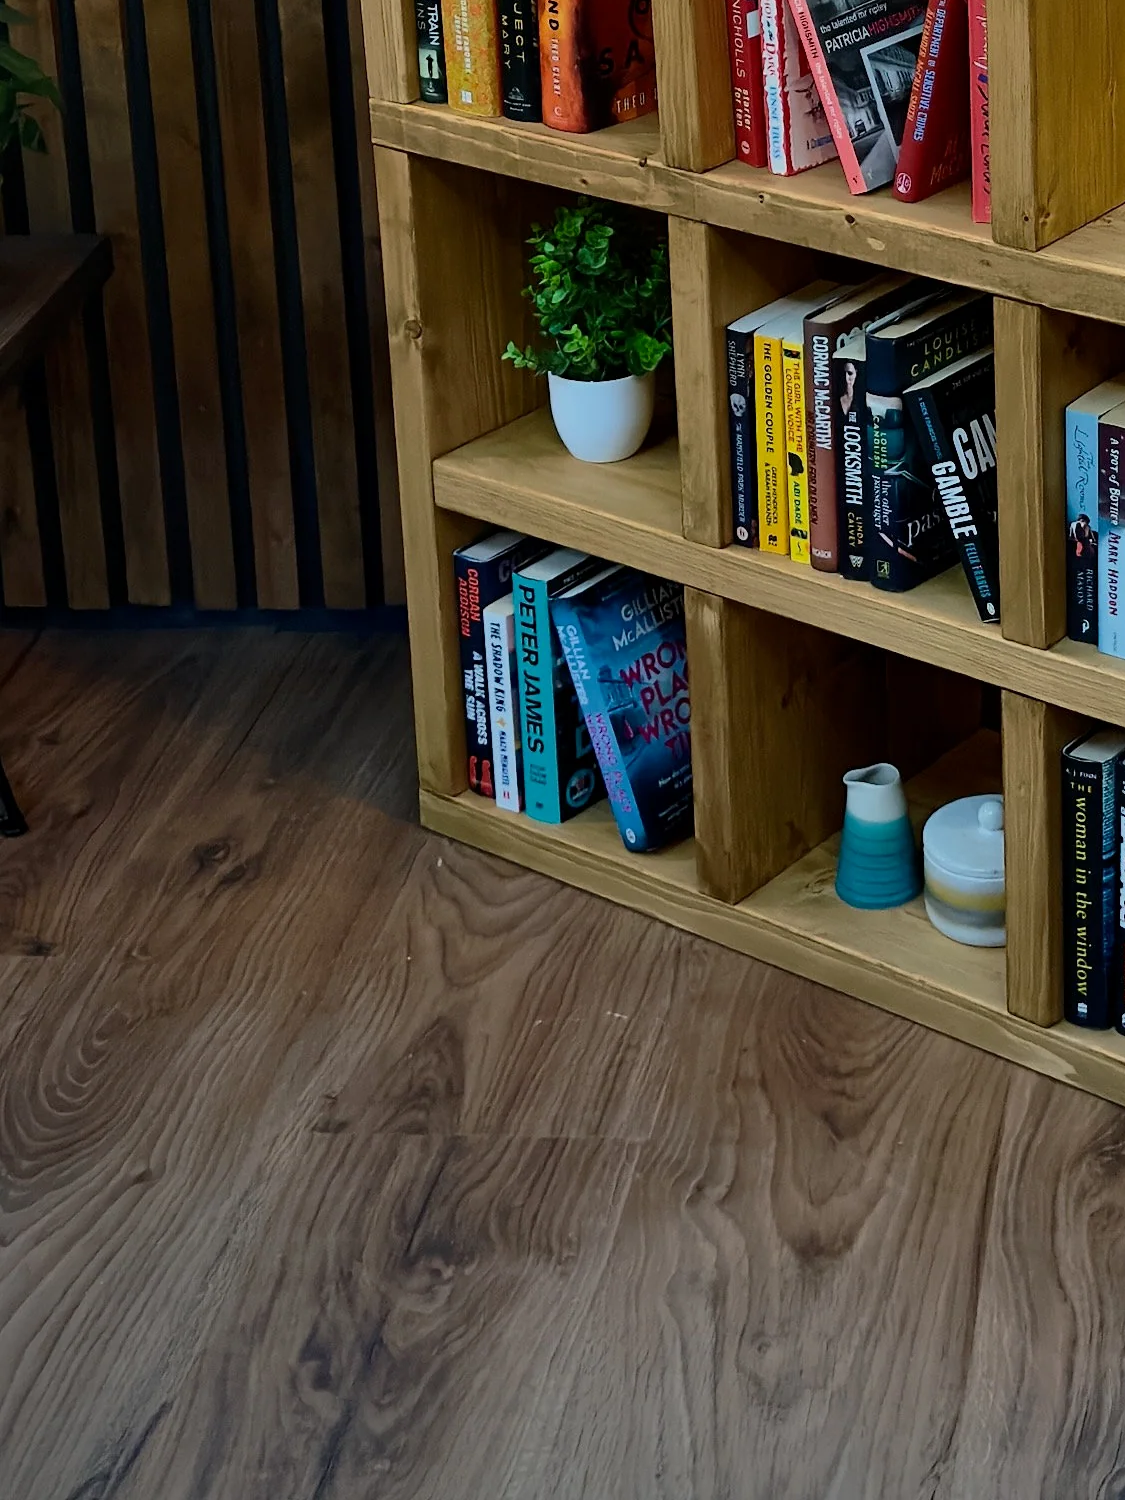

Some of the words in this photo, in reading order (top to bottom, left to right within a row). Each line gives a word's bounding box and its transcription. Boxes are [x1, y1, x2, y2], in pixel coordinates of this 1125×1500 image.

[427, 3, 440, 46] TRAIN
[798, 12, 819, 58] HIGHSMITH
[820, 22, 832, 34] the
[831, 13, 857, 30] talented
[858, 9, 868, 20] mr
[868, 2, 888, 16] ripley
[918, 8, 935, 58] ALEXANDER
[928, 8, 946, 58] DEPARTMENT
[501, 14, 511, 69] MARY
[825, 25, 870, 53] PATRICIA
[734, 86, 742, 106] for
[742, 88, 751, 131] starter
[906, 93, 918, 121] SMITH
[919, 69, 935, 111] SENSITIVE
[913, 111, 928, 141] CRIMES
[763, 342, 772, 361] THE
[924, 320, 976, 356] LOUISE
[727, 340, 737, 387] SHEPHERD
[736, 353, 745, 378] LYNN
[812, 336, 830, 387] CORMAC
[764, 364, 773, 409] GOLDEN
[765, 412, 774, 453] COUPLE
[814, 388, 832, 451] McCARTHY
[872, 415, 880, 469] CANDLISH
[1109, 437, 1119, 445] A
[843, 425, 863, 505] LOCKSMITH
[882, 480, 891, 497] the
[931, 460, 978, 540] GAMBLE
[847, 512, 855, 547] CALVEY
[856, 516, 864, 545] LINDA
[882, 498, 892, 526] other
[1108, 531, 1121, 565] MARK
[964, 542, 980, 563] FELIX
[972, 564, 992, 598] FRANCIS
[1076, 571, 1085, 605] MASON
[1085, 568, 1094, 611] RICHARD
[458, 576, 471, 638] ADDISON
[467, 567, 481, 622] CORBAN
[1108, 569, 1119, 616] HADDON
[490, 622, 501, 642] THE
[519, 584, 539, 667] PETER
[472, 651, 483, 660] A
[491, 644, 504, 685] SHADOW
[565, 624, 592, 680] GILLIAN
[464, 669, 474, 691] THE
[473, 664, 486, 699] WALK
[495, 687, 506, 713] KING
[466, 694, 476, 720] SUN
[476, 699, 488, 745] ACROSS
[523, 670, 544, 754] JAMES
[1070, 781, 1092, 794] THE
[1075, 797, 1086, 861] woman
[1075, 866, 1092, 885] in
[1075, 891, 1092, 920] the
[1076, 926, 1092, 997] window
